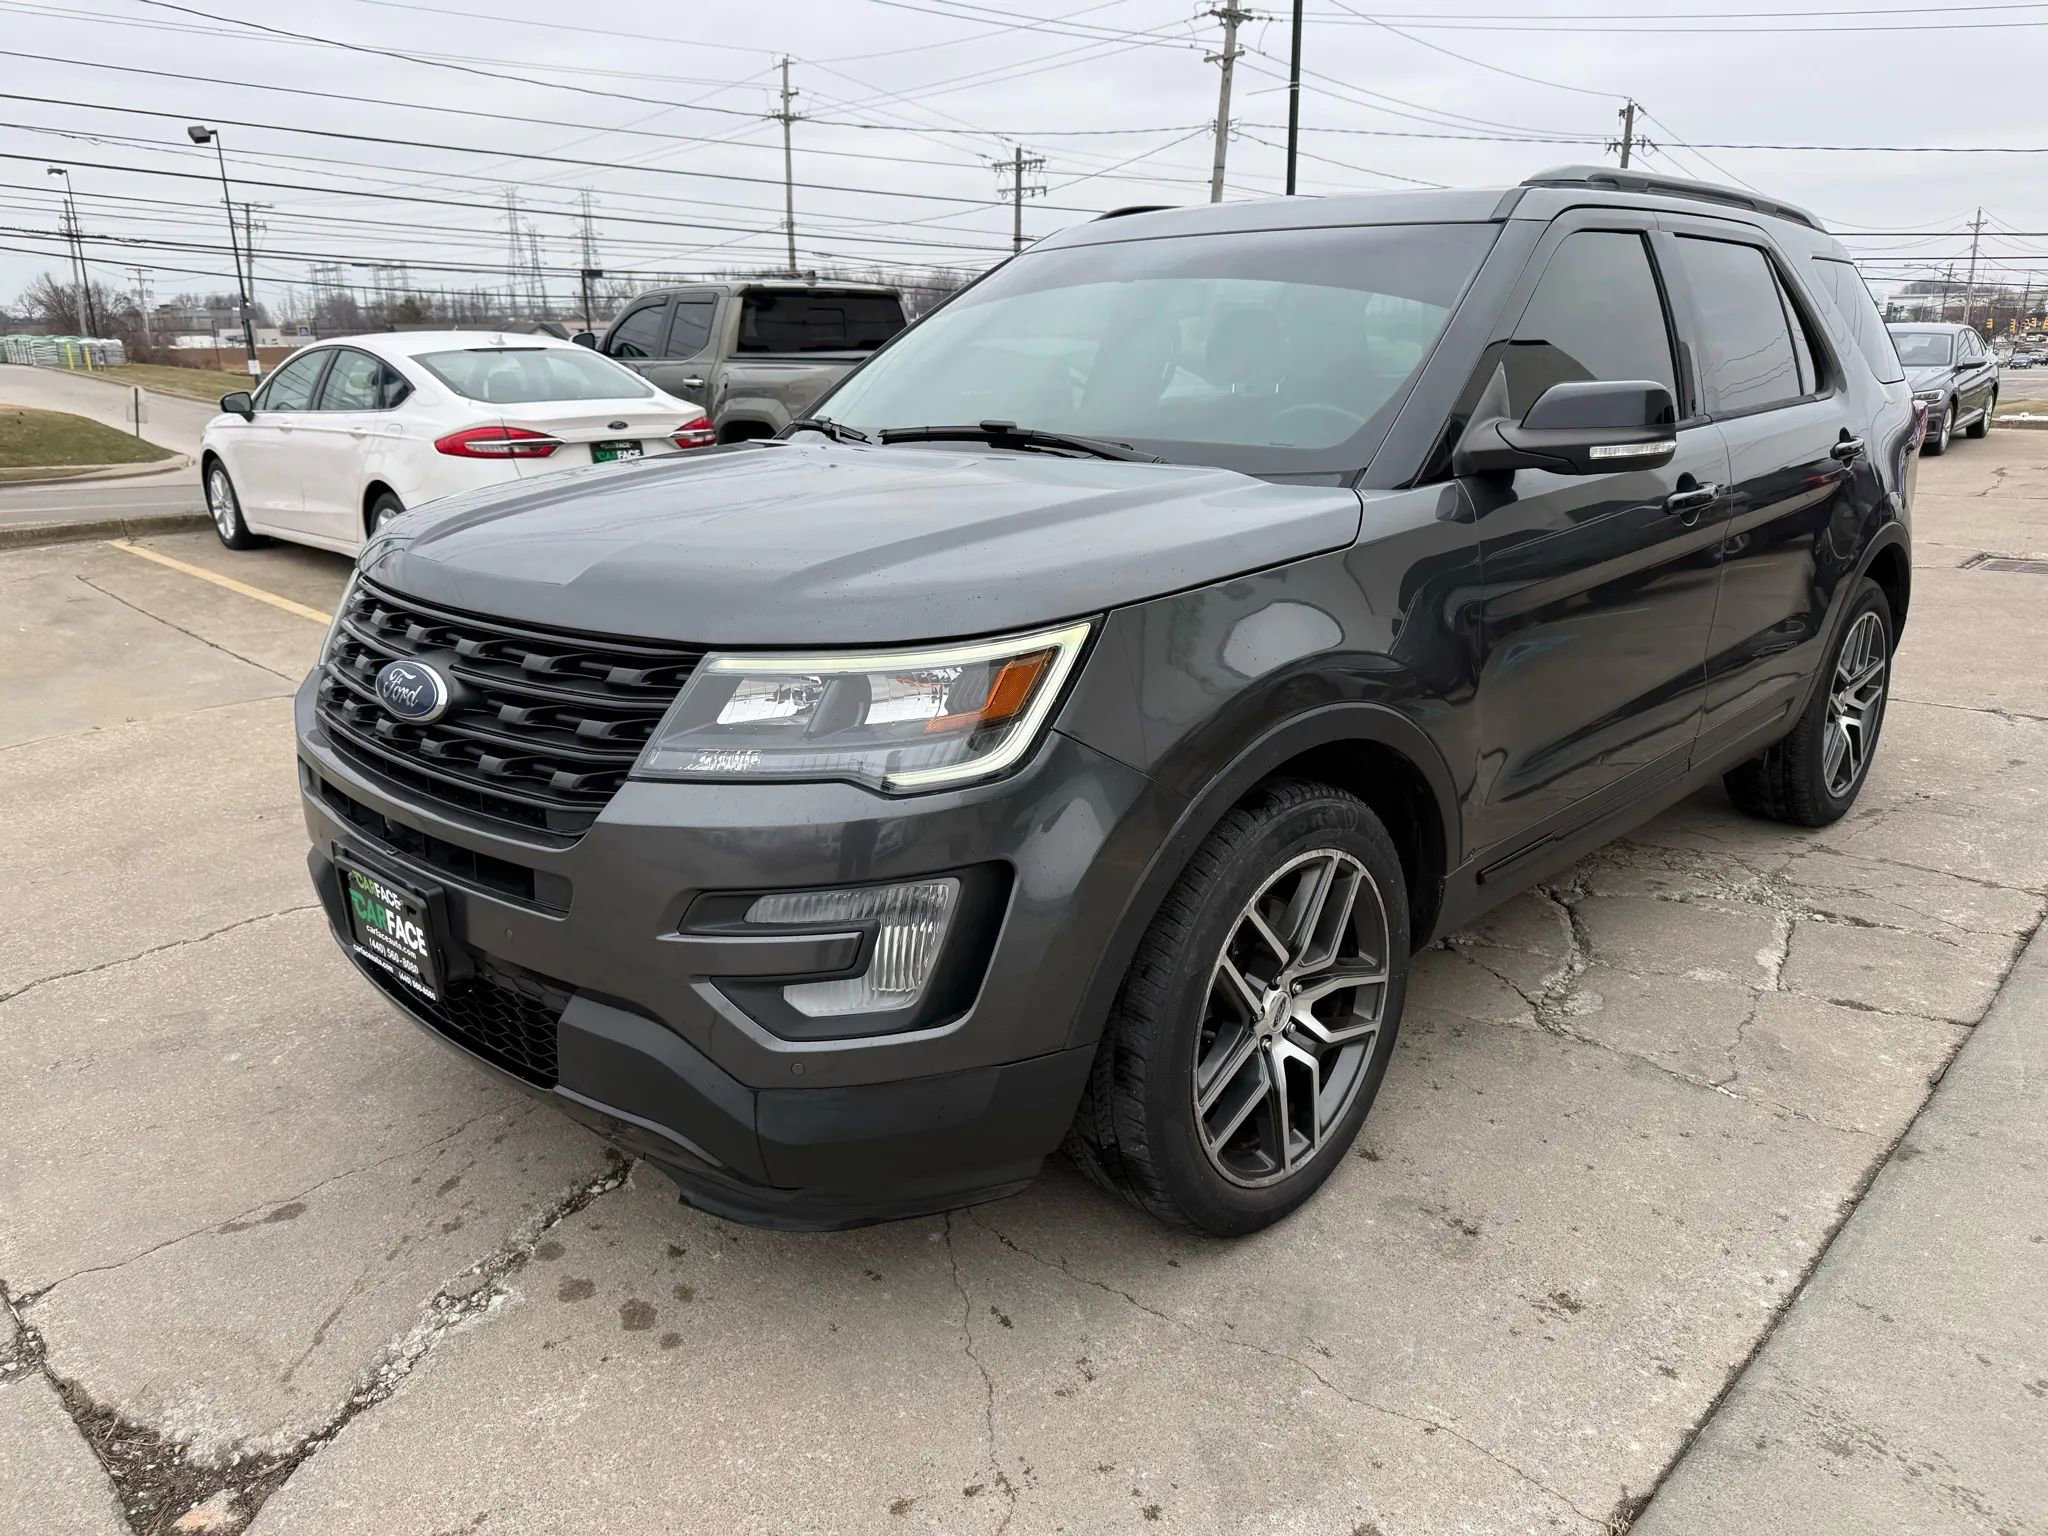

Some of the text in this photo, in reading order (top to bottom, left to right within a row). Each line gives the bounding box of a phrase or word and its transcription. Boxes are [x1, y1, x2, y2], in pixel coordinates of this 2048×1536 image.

[382, 667, 424, 708] Ford
[352, 870, 402, 911] CARFACE
[349, 887, 428, 957] CARFACE
